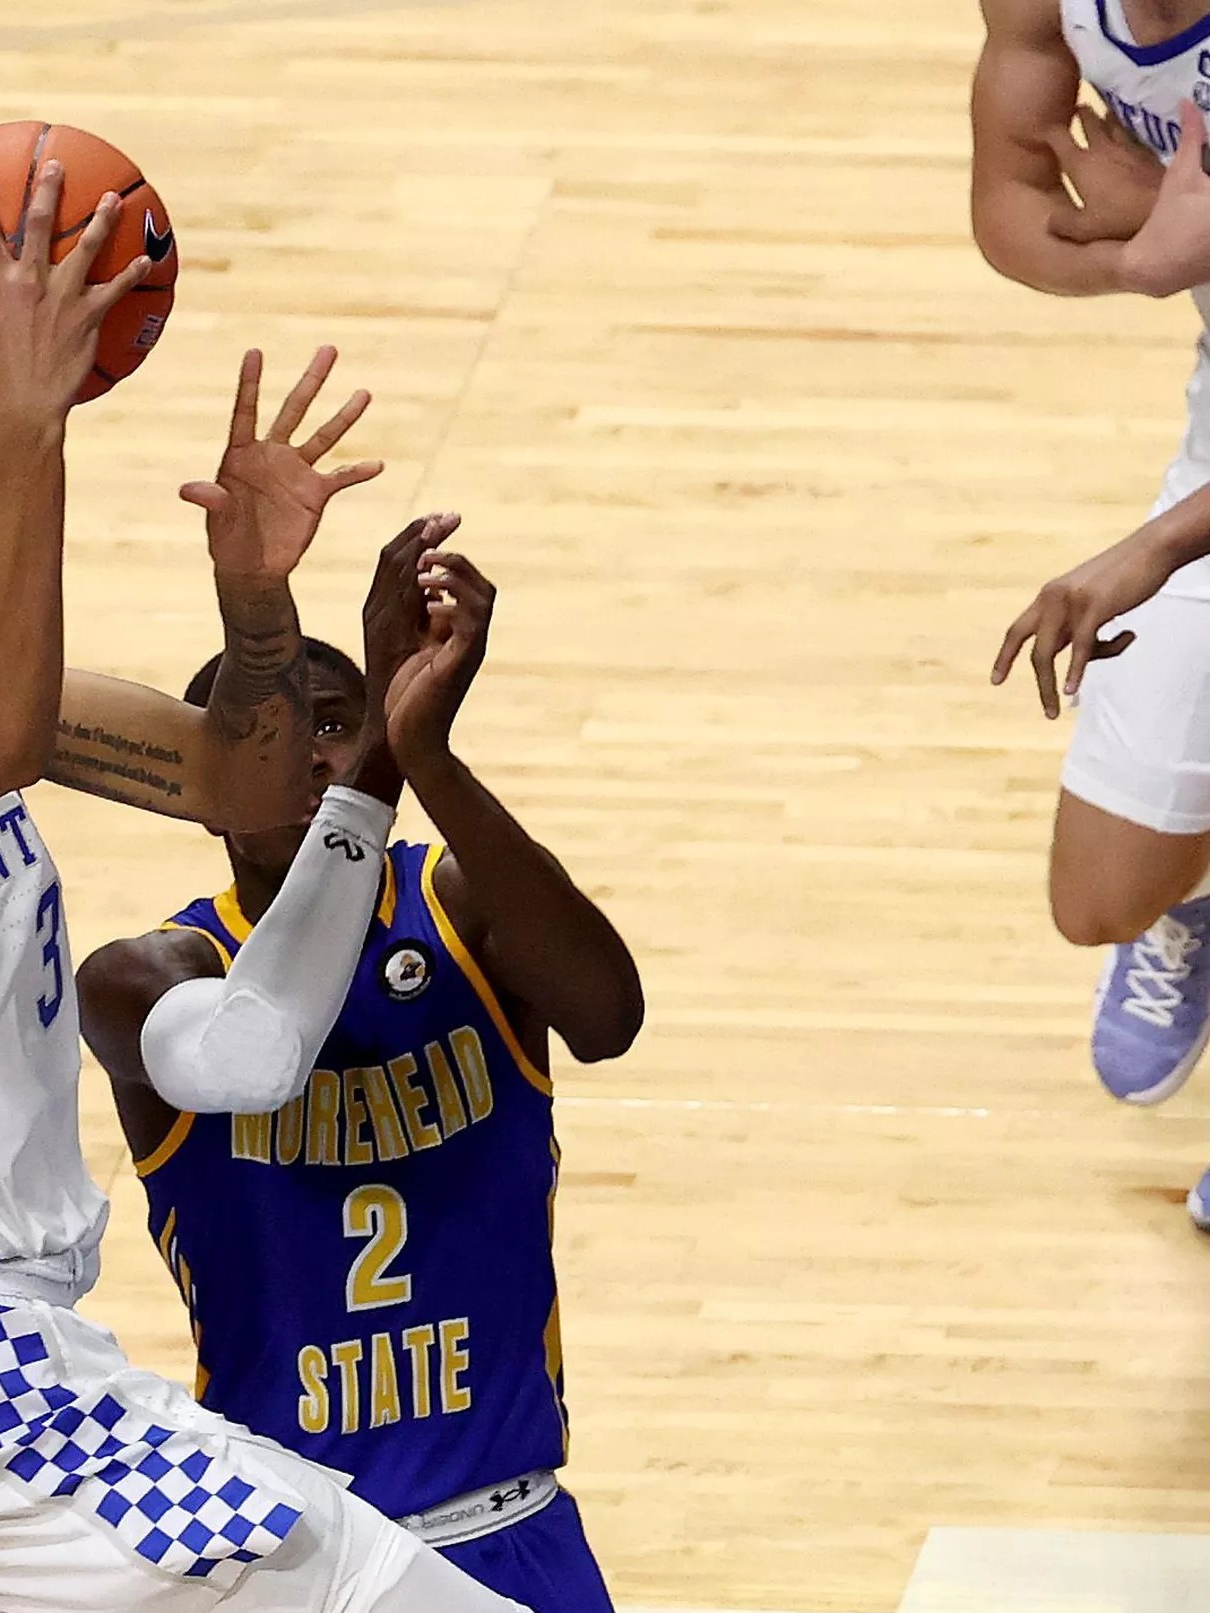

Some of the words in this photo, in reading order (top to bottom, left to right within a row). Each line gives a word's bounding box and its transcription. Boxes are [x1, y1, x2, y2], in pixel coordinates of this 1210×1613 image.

[36, 880, 64, 1029] 3
[342, 1183, 412, 1313] 2
[297, 1316, 472, 1435] STATE
